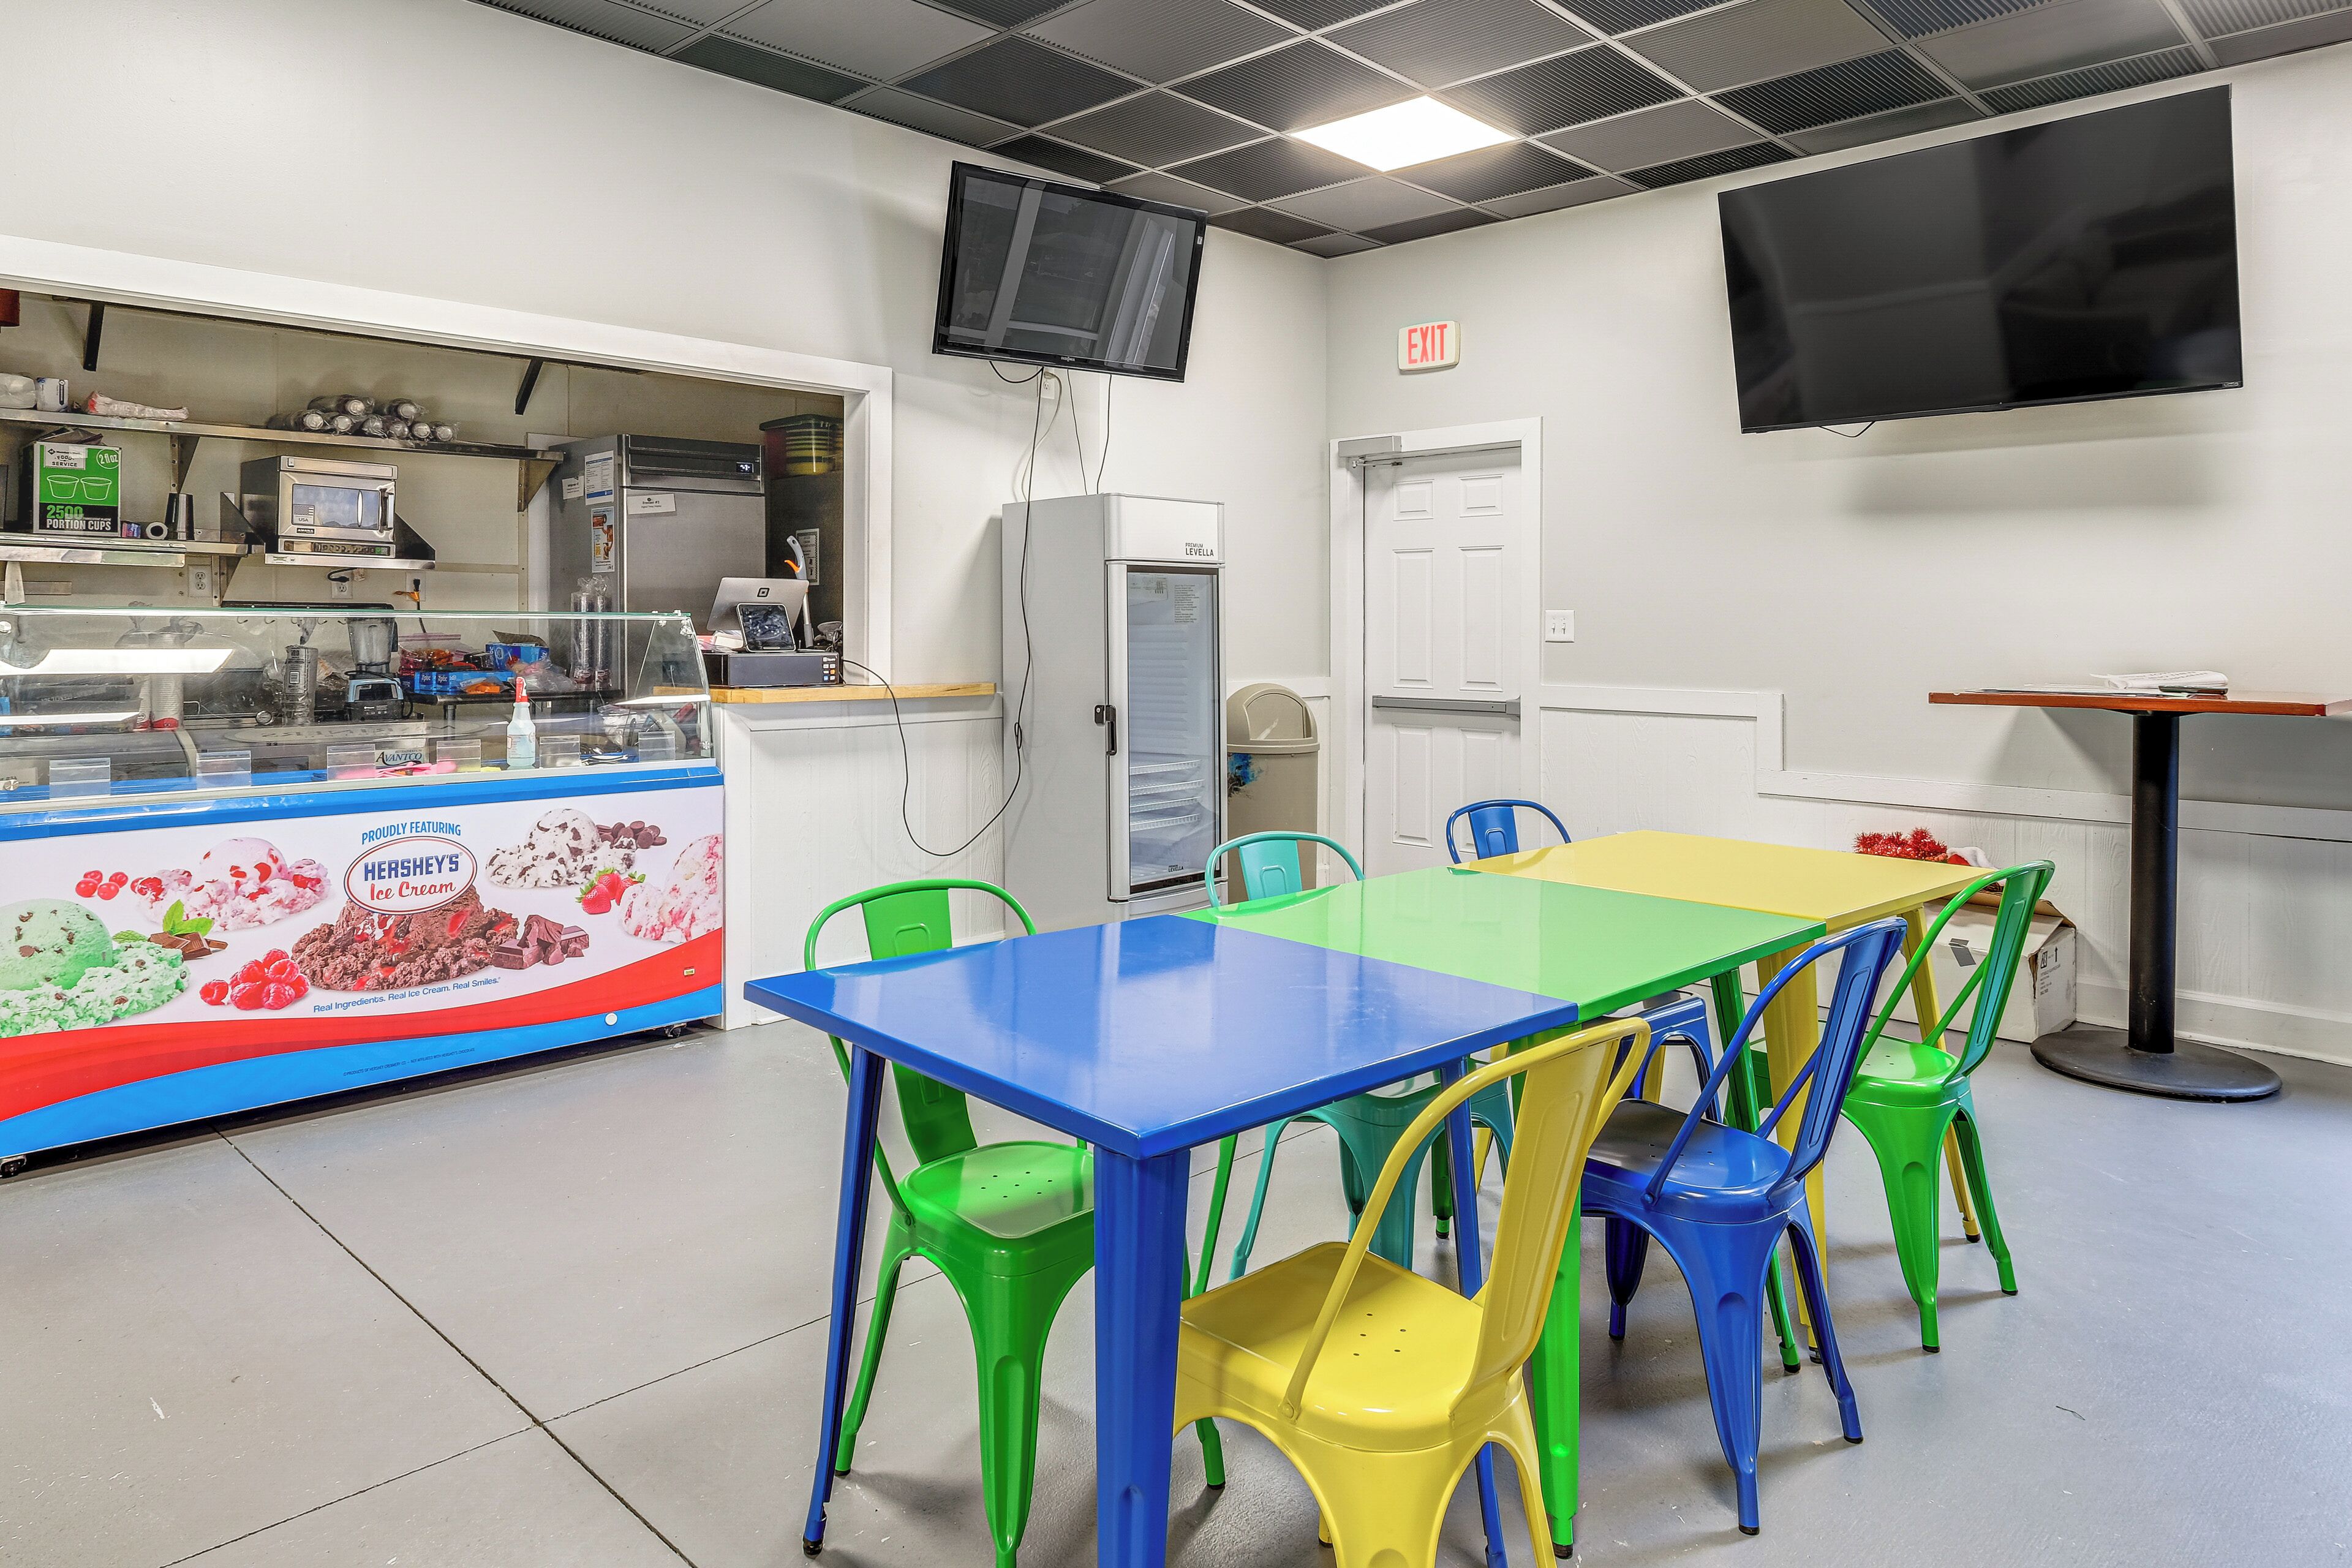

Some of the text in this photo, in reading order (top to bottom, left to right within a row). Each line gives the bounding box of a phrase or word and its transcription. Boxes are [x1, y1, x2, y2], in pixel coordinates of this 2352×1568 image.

[1408, 323, 1447, 364] EXIT
[99, 454, 105, 464] 2
[110, 454, 118, 463] oz
[47, 505, 83, 520] 2500
[46, 519, 111, 531] PORTION CUPS
[1185, 548, 1214, 557] LEVELLA
[375, 752, 422, 764] AVANTCO
[361, 821, 461, 845] PROUDLY FEATURING
[364, 853, 459, 882] HERSHEY'S
[370, 881, 456, 901] Ice Cream
[314, 1003, 333, 1013] Real
[335, 995, 386, 1011] Ingredients.
[388, 991, 406, 1001] Real
[422, 985, 451, 995] Cream.
[453, 981, 470, 990] Real
